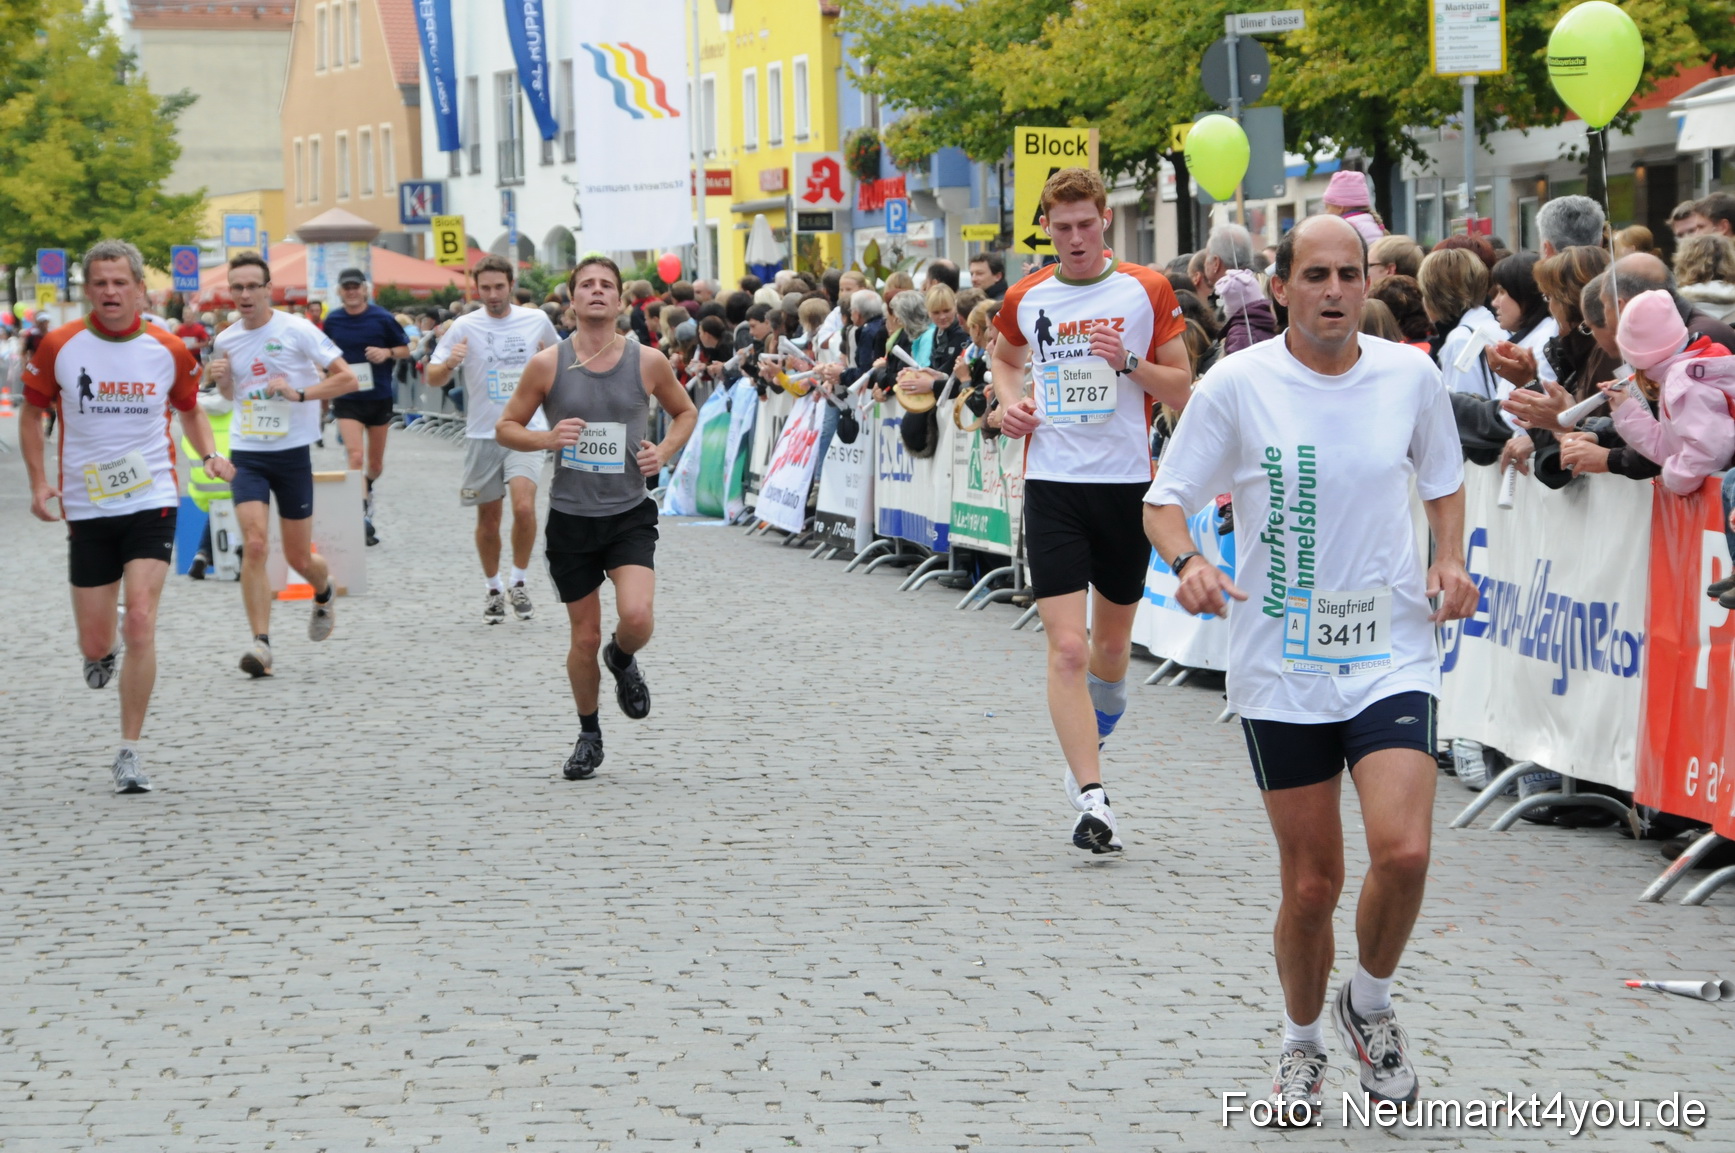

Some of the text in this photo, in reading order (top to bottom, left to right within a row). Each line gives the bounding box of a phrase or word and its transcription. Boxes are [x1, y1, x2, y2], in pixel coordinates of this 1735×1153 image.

[1445, 3, 1490, 13] Marktplatz
[1240, 14, 1300, 29] Ulmer Gasse
[1025, 133, 1088, 156] Block
[435, 217, 461, 227] Block
[890, 202, 903, 231] P
[442, 231, 459, 254] B
[174, 276, 197, 288] TAXI
[1055, 332, 1092, 346] Reis
[1050, 348, 1083, 359] TEAM
[1063, 369, 1092, 381] Stefan
[98, 381, 156, 396] MERZ
[501, 382, 519, 392] 28
[1050, 387, 1055, 396] A
[96, 389, 145, 403] Reisen
[1066, 386, 1109, 403] 2787
[89, 405, 149, 414] TEAM 2008
[257, 416, 281, 428] 775
[580, 427, 607, 437] Patrick
[579, 441, 617, 455] 2066
[98, 457, 127, 471] Jochen
[108, 467, 138, 488] 281
[1289, 444, 1317, 589] mmelsbrunn
[1260, 445, 1287, 618] NaturFreunde
[1317, 596, 1375, 618] Siegfried
[1292, 618, 1298, 630] A
[1317, 620, 1376, 646] 3411
[1350, 659, 1391, 671] PFLEIDERER
